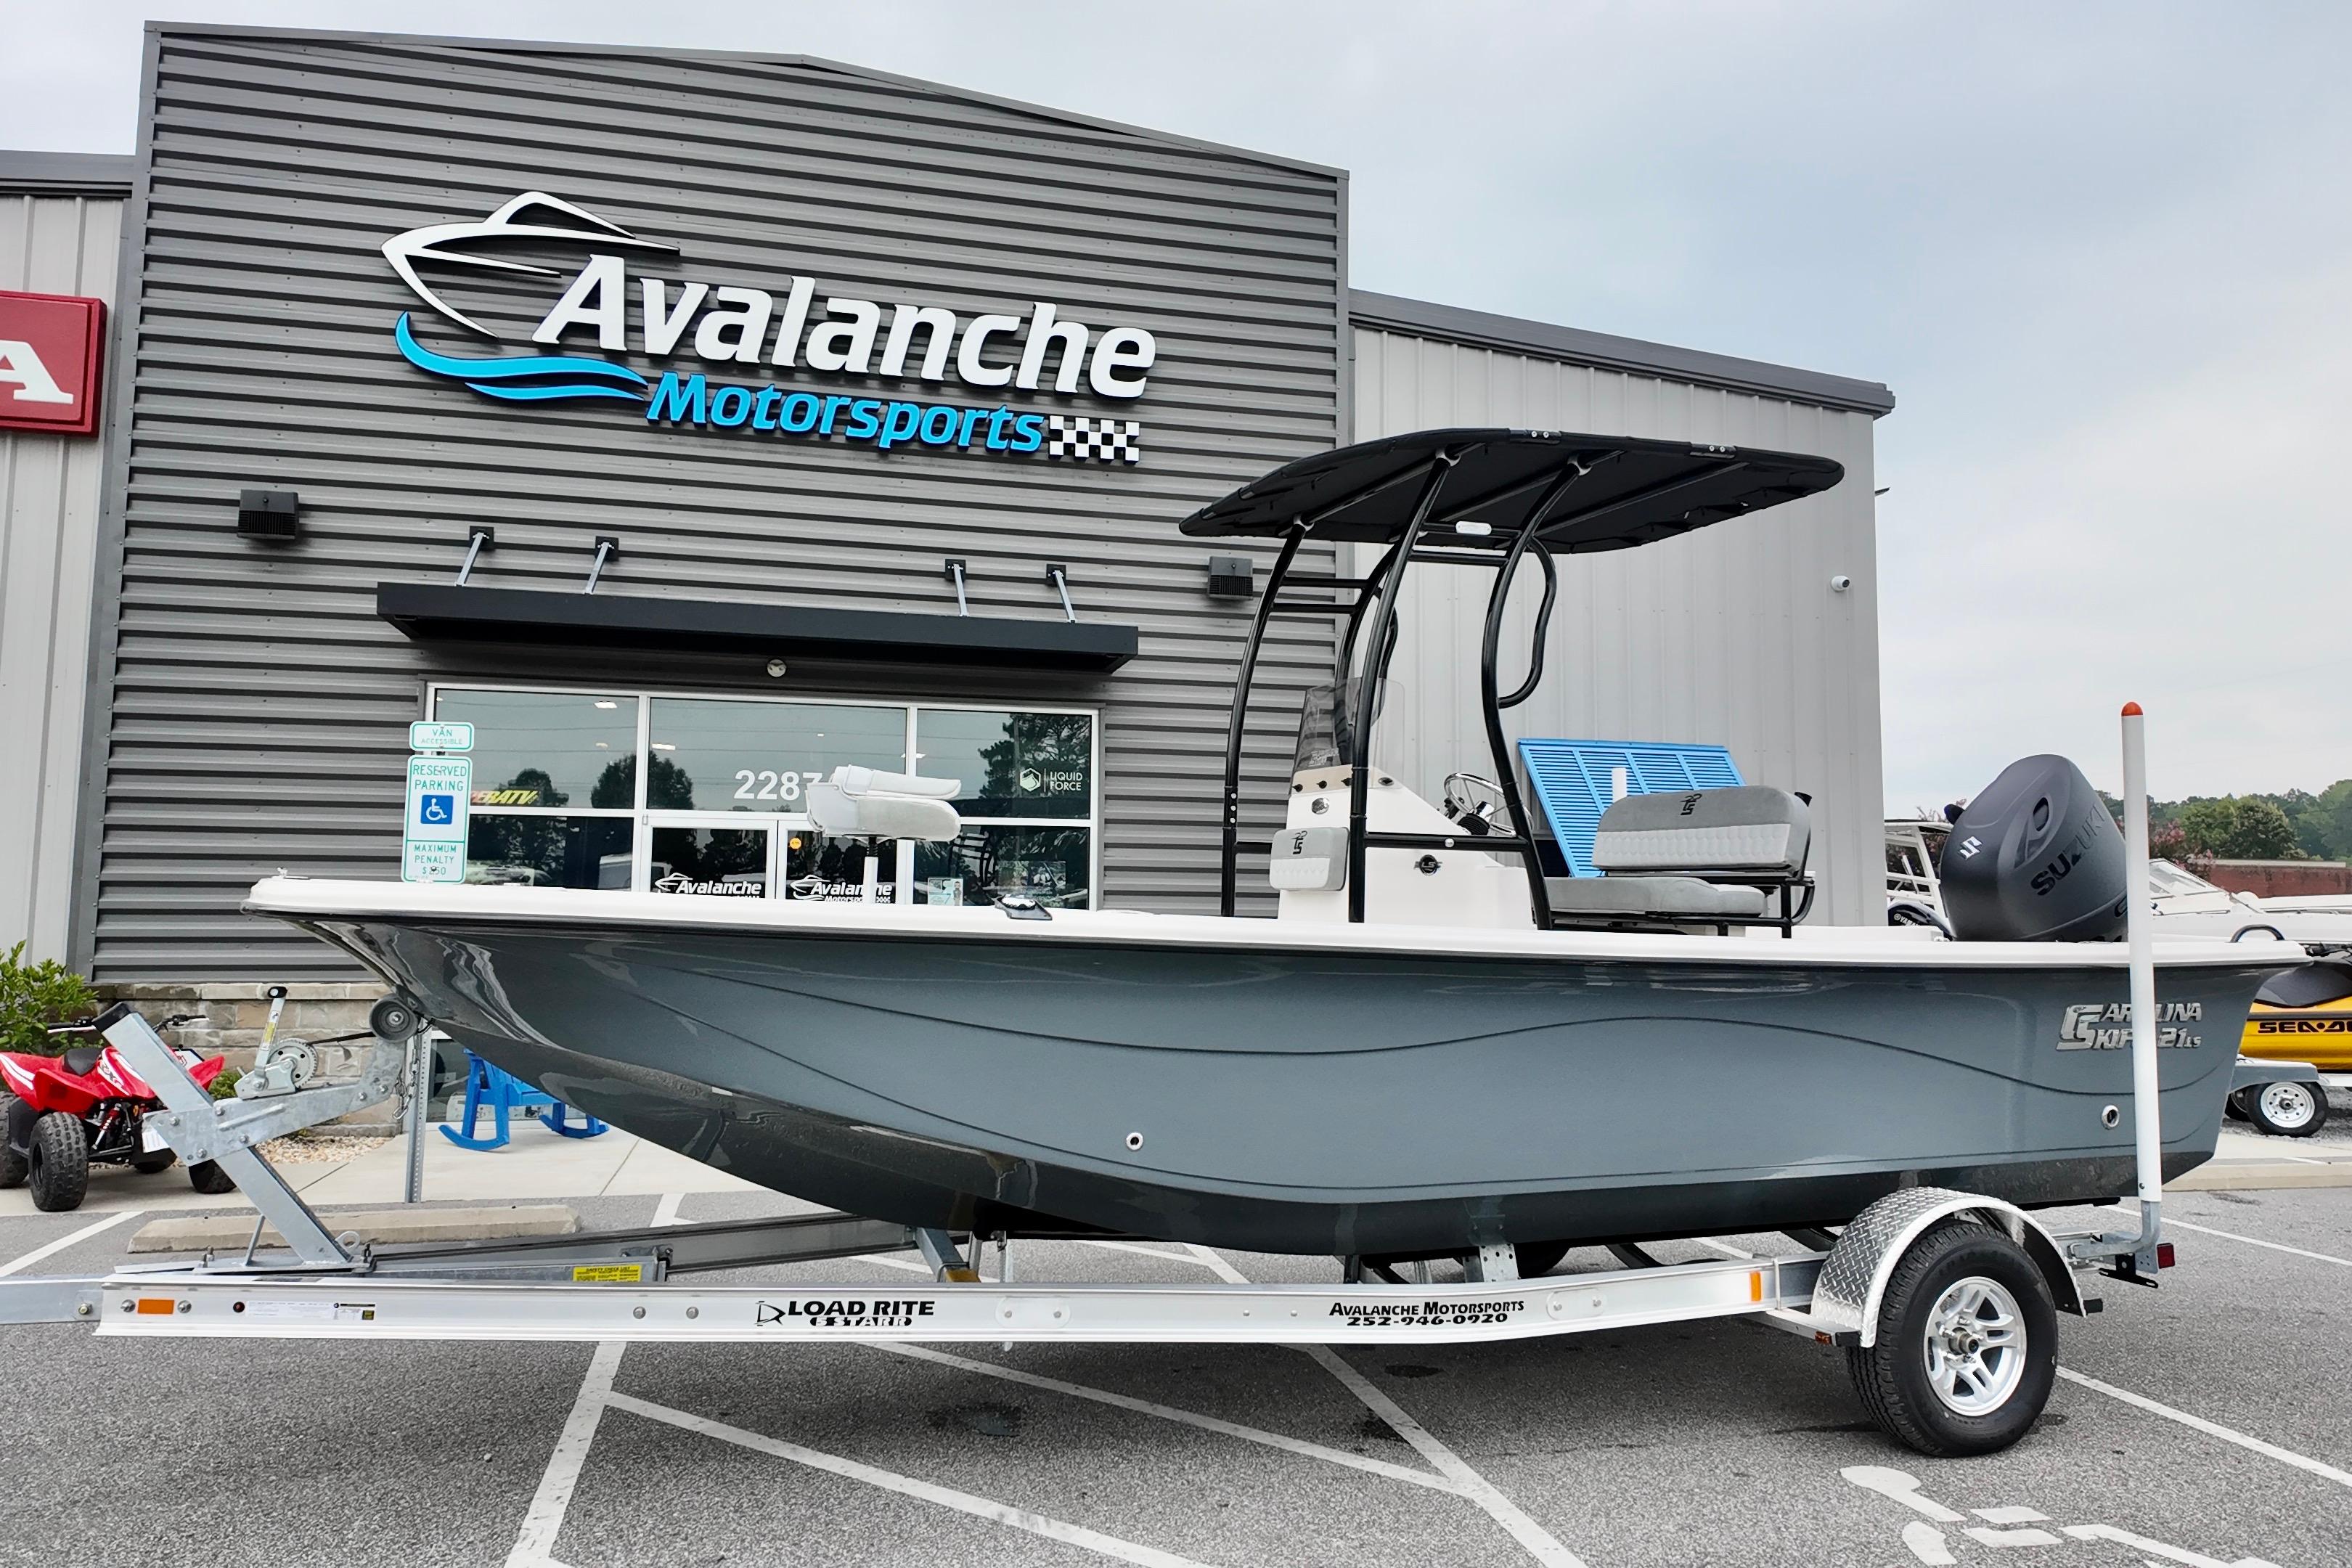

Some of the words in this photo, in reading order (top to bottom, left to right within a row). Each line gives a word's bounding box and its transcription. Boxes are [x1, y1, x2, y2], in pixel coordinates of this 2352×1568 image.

[531, 253, 1156, 399] Avalanche
[645, 370, 1045, 453] Motorsports
[412, 764, 467, 777] RESERVED
[1050, 771, 1083, 781] LIQUID
[414, 779, 465, 792] PARKING
[1050, 781, 1082, 791] FORCE
[414, 844, 457, 853] MAXIMUM
[2030, 804, 2105, 896] SUZUKI
[415, 855, 454, 864] PENALTY
[675, 880, 762, 895] Avalanche
[810, 881, 893, 896] Avalane
[788, 1300, 866, 1315] LOAD
[873, 1300, 936, 1315] RITE
[1328, 1302, 1419, 1316] AVALANCHE
[1423, 1300, 1525, 1315] MOTORSPORTS
[815, 1316, 828, 1326] 5
[1347, 1312, 1508, 1326] 252-946-0920
